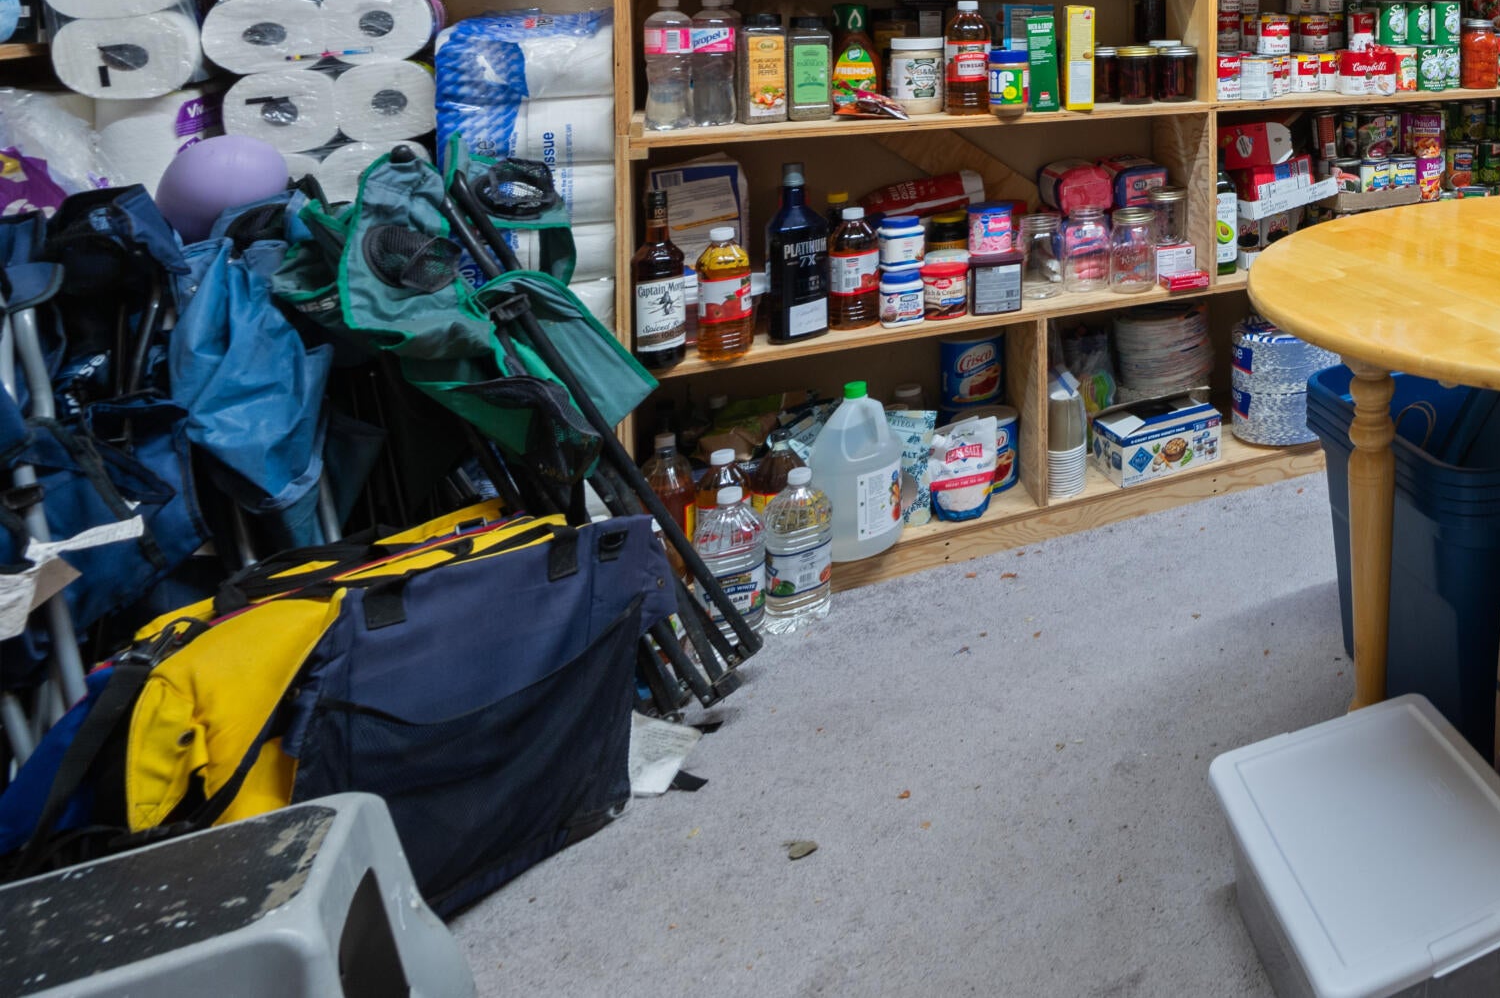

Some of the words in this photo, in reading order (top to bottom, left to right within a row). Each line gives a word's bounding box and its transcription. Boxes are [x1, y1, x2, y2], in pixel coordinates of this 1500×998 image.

[692, 29, 721, 48] propel
[784, 237, 827, 260] PLATINUM
[638, 285, 666, 299] Captain
